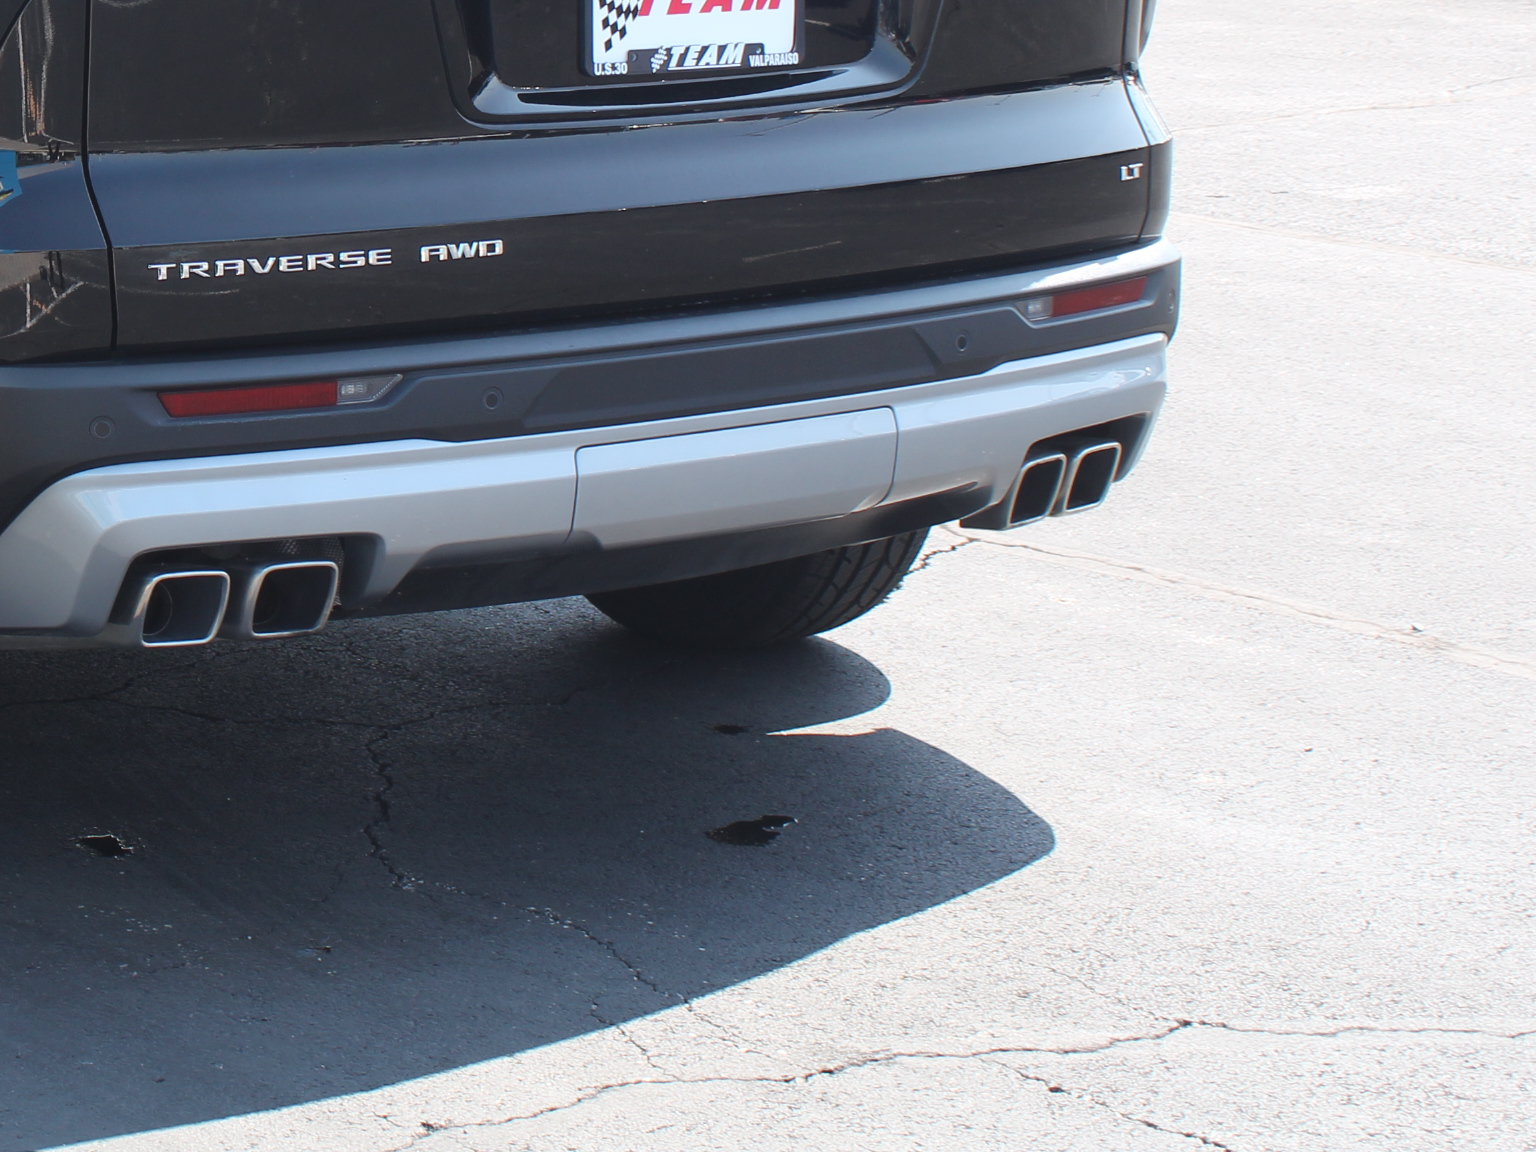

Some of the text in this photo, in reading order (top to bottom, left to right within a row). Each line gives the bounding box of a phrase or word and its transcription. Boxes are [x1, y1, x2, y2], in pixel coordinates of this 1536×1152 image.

[667, 42, 746, 67] TEAM
[749, 51, 800, 67] VALPARAISO
[1120, 162, 1144, 181] LT
[148, 239, 505, 281] TRAVERSE AWD
